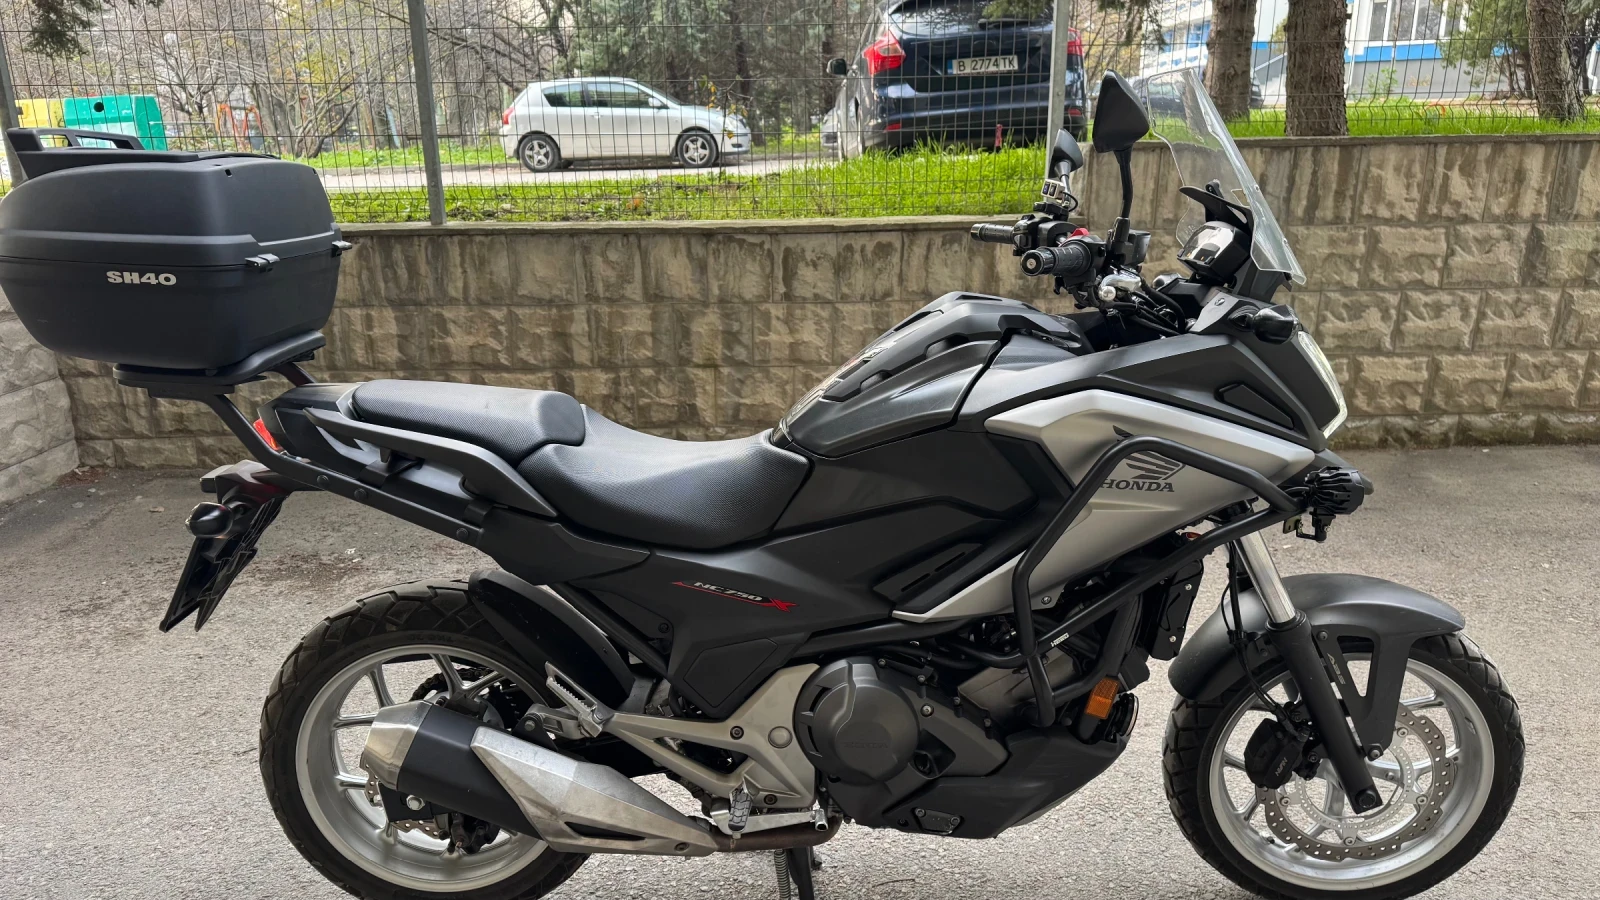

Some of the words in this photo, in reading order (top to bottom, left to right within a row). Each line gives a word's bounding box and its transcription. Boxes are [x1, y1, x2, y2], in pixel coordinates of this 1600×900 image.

[971, 58, 999, 71] 2774
[1001, 57, 1016, 69] TK
[106, 271, 177, 286] SH40
[1099, 478, 1175, 493] HONDA
